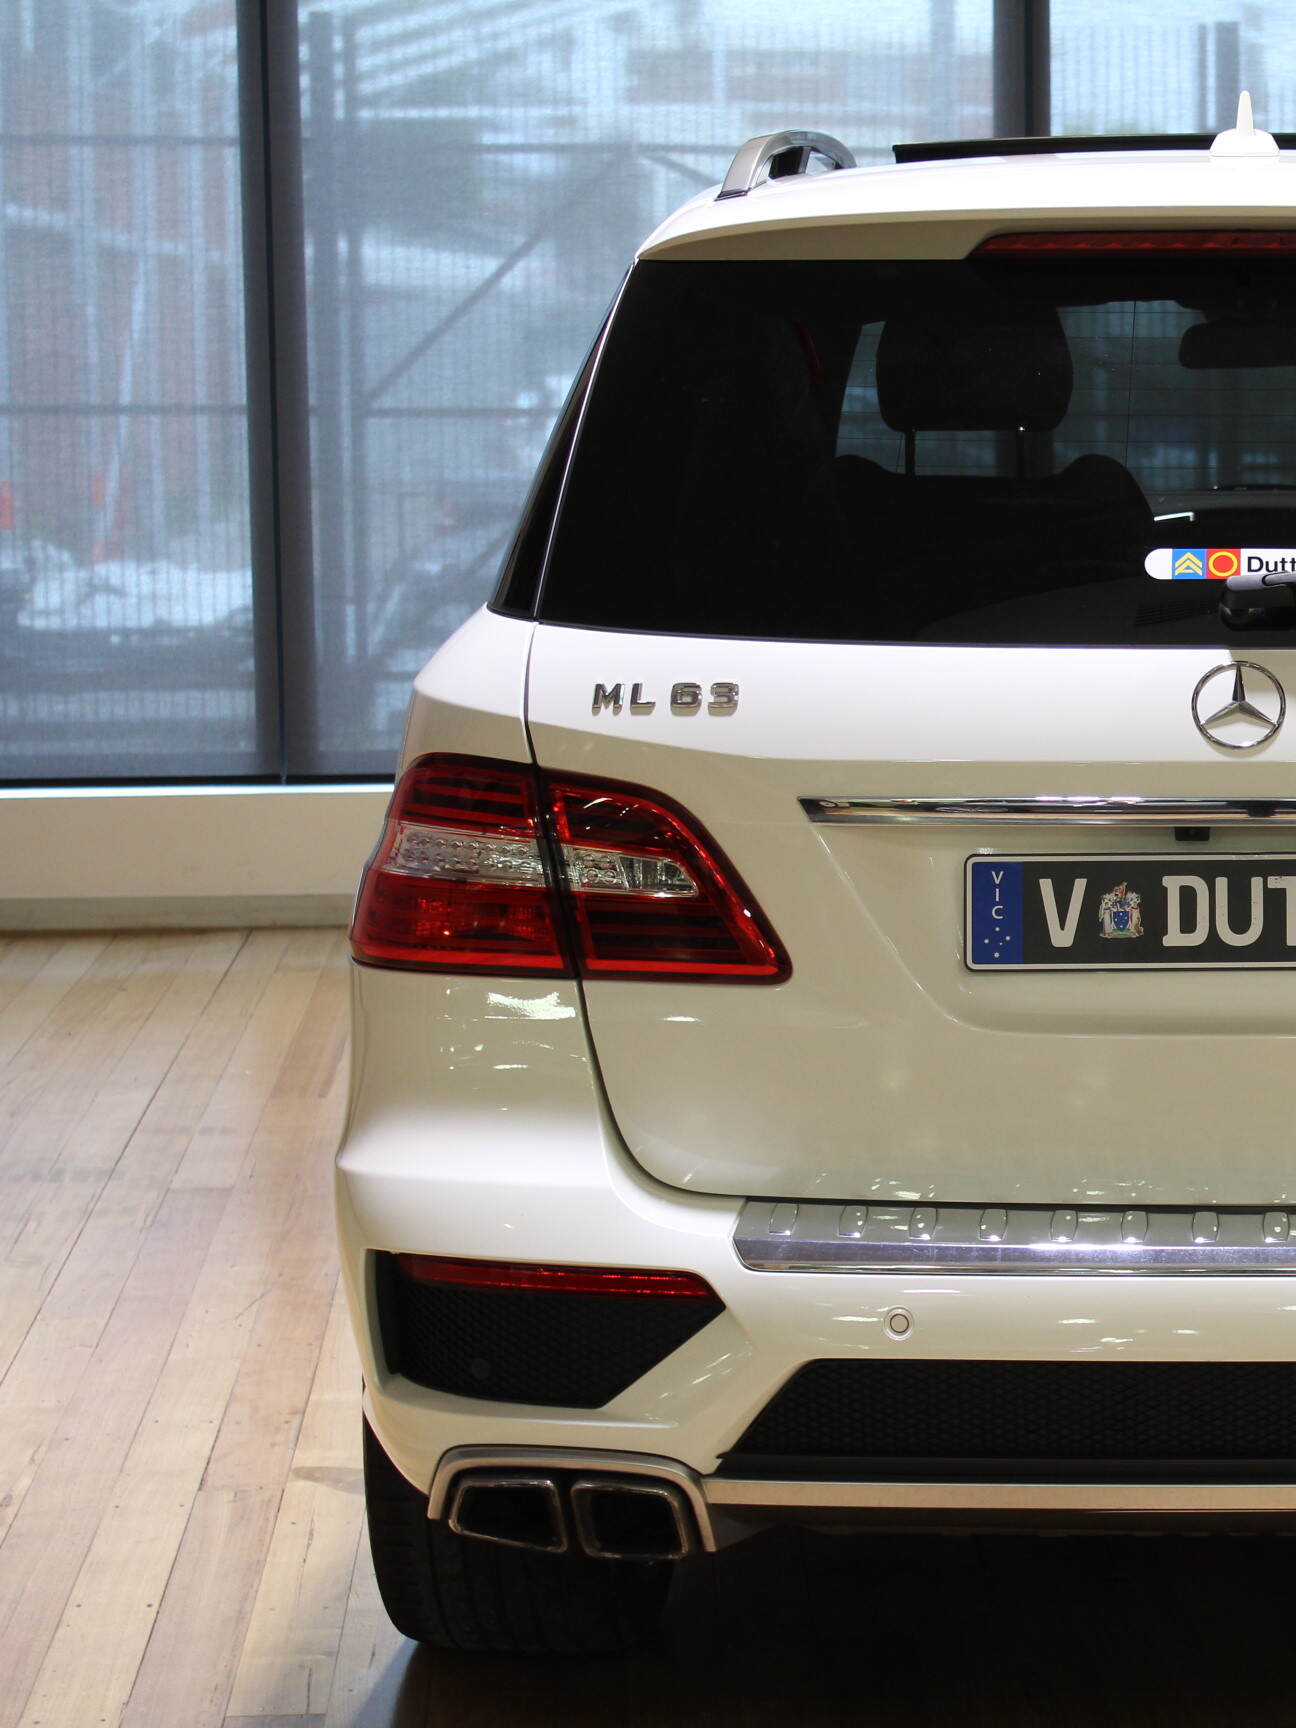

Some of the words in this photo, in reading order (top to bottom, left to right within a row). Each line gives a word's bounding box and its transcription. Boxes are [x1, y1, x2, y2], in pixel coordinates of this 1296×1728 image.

[592, 682, 656, 713] ML
[670, 682, 739, 714] 63
[991, 870, 1004, 920] VIC
[1039, 878, 1087, 947] V
